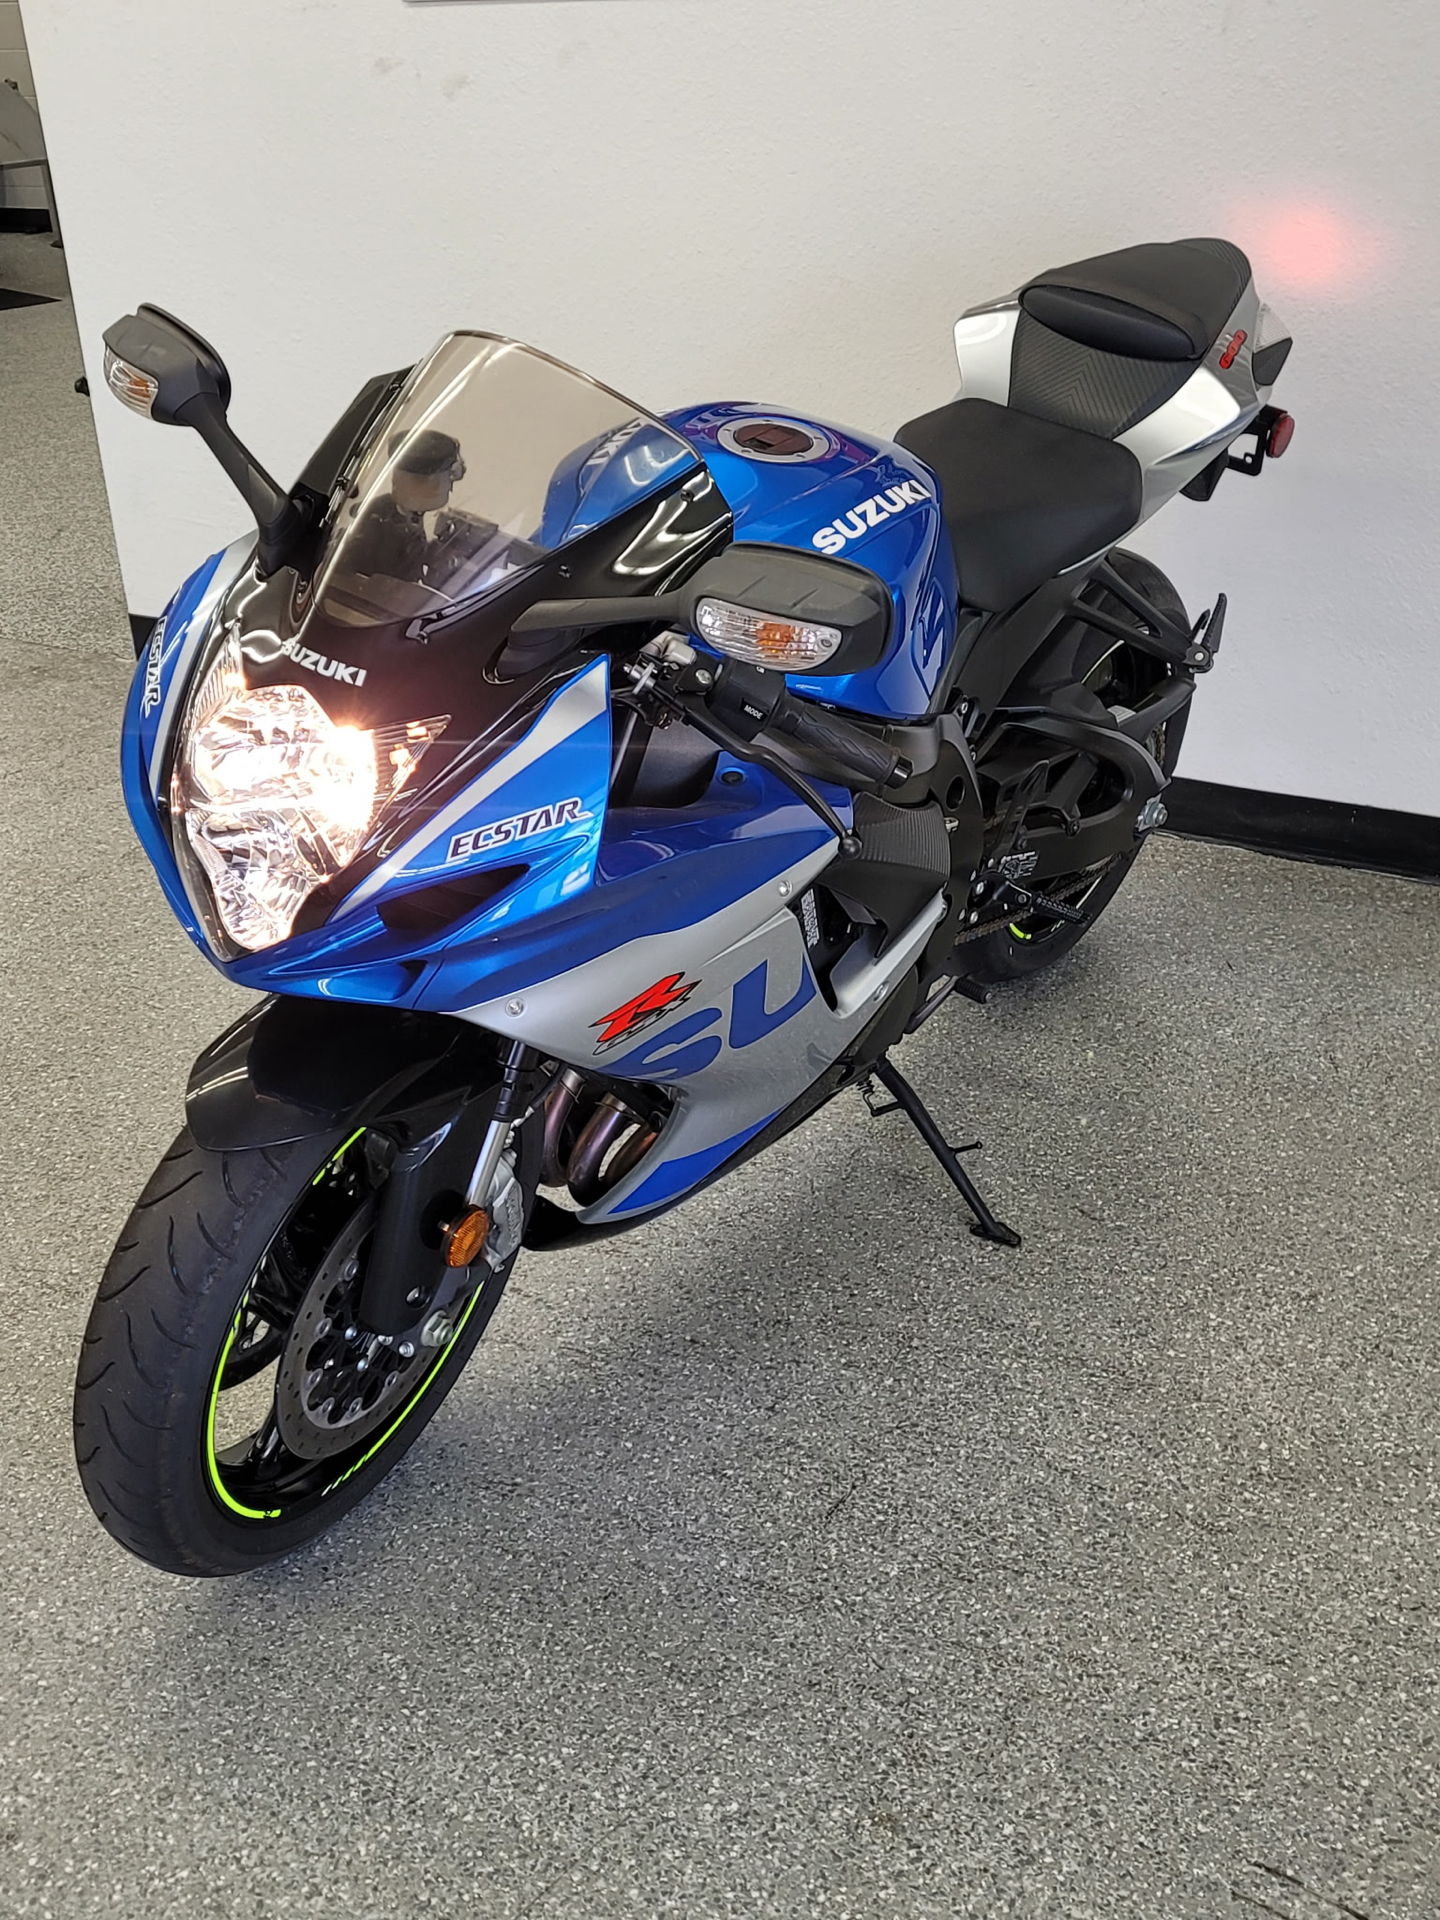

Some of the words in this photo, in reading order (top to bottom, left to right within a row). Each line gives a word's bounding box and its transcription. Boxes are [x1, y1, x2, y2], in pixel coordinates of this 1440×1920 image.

[812, 479, 931, 555] SUZUKI
[145, 616, 167, 718] ECSTAR
[282, 640, 367, 687] SUZUKI
[744, 704, 763, 720] MODE
[447, 797, 592, 861] ECSTAR
